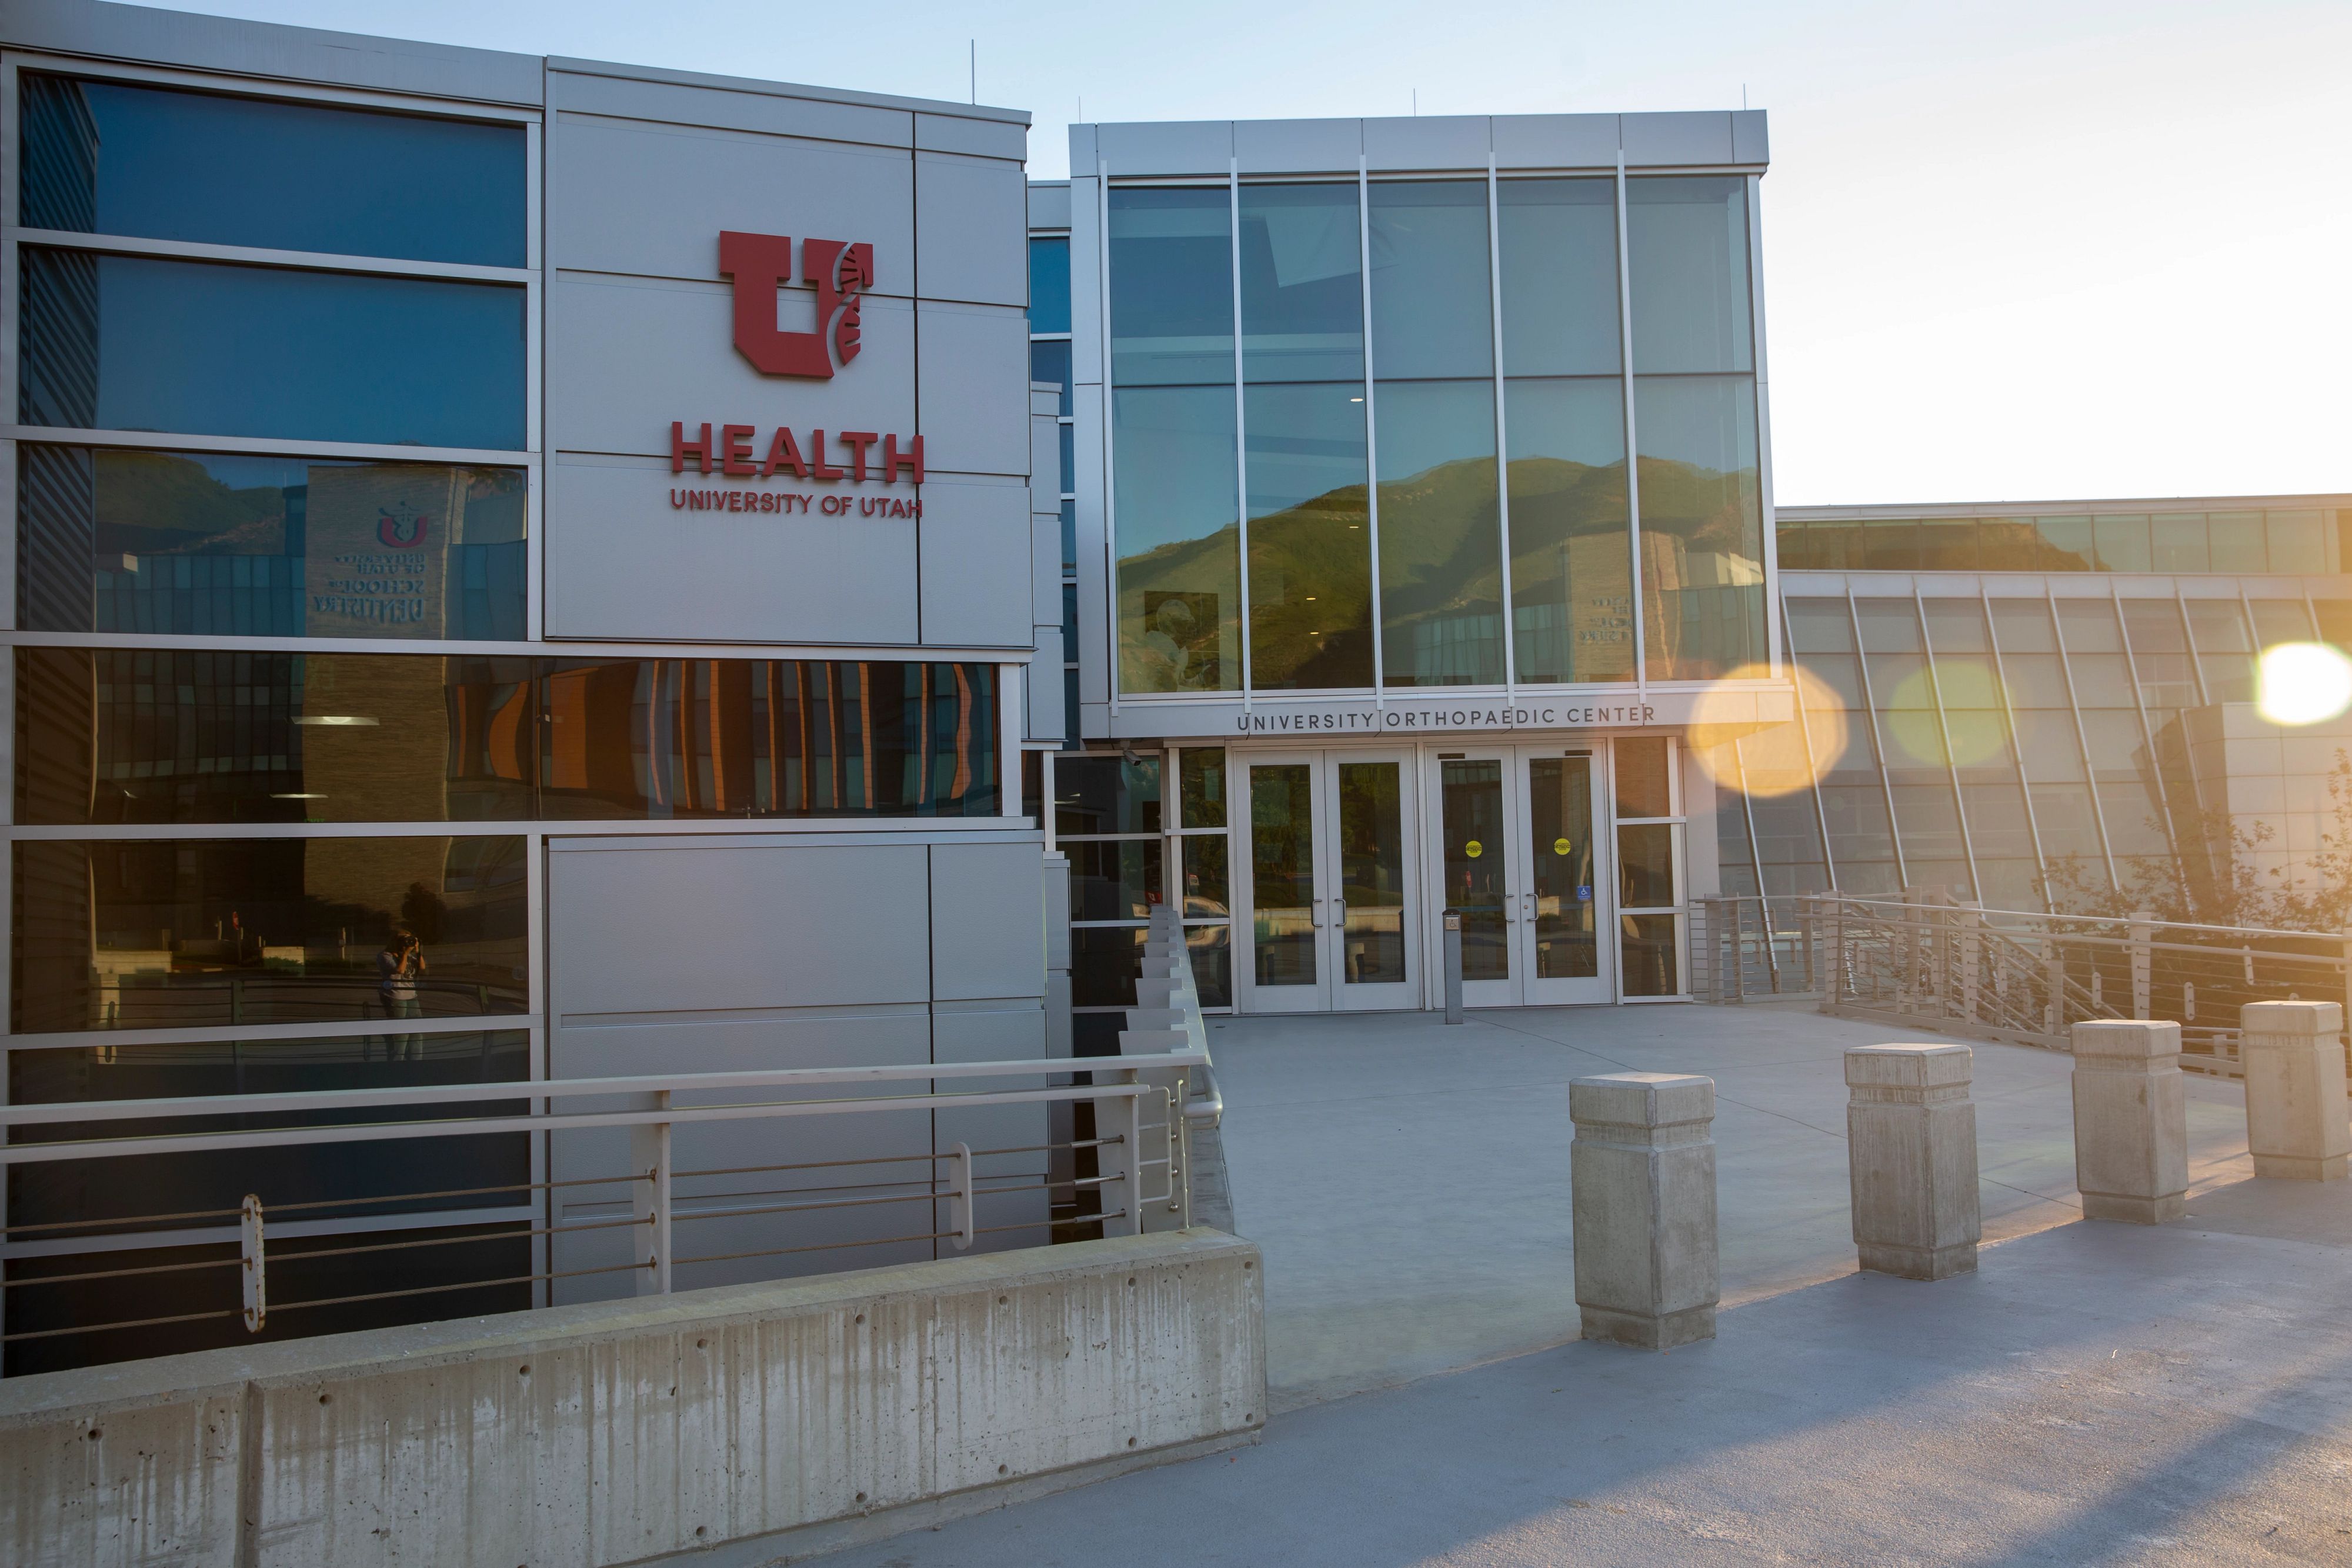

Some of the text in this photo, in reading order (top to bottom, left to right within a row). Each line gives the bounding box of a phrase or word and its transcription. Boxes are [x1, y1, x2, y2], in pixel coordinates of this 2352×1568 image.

[672, 422, 924, 484] HEALTH
[670, 489, 923, 518] UNIVERSITY OF UTAH
[1237, 706, 1654, 730] UNIVERSITY ORTHOPAEDIC CENTER
